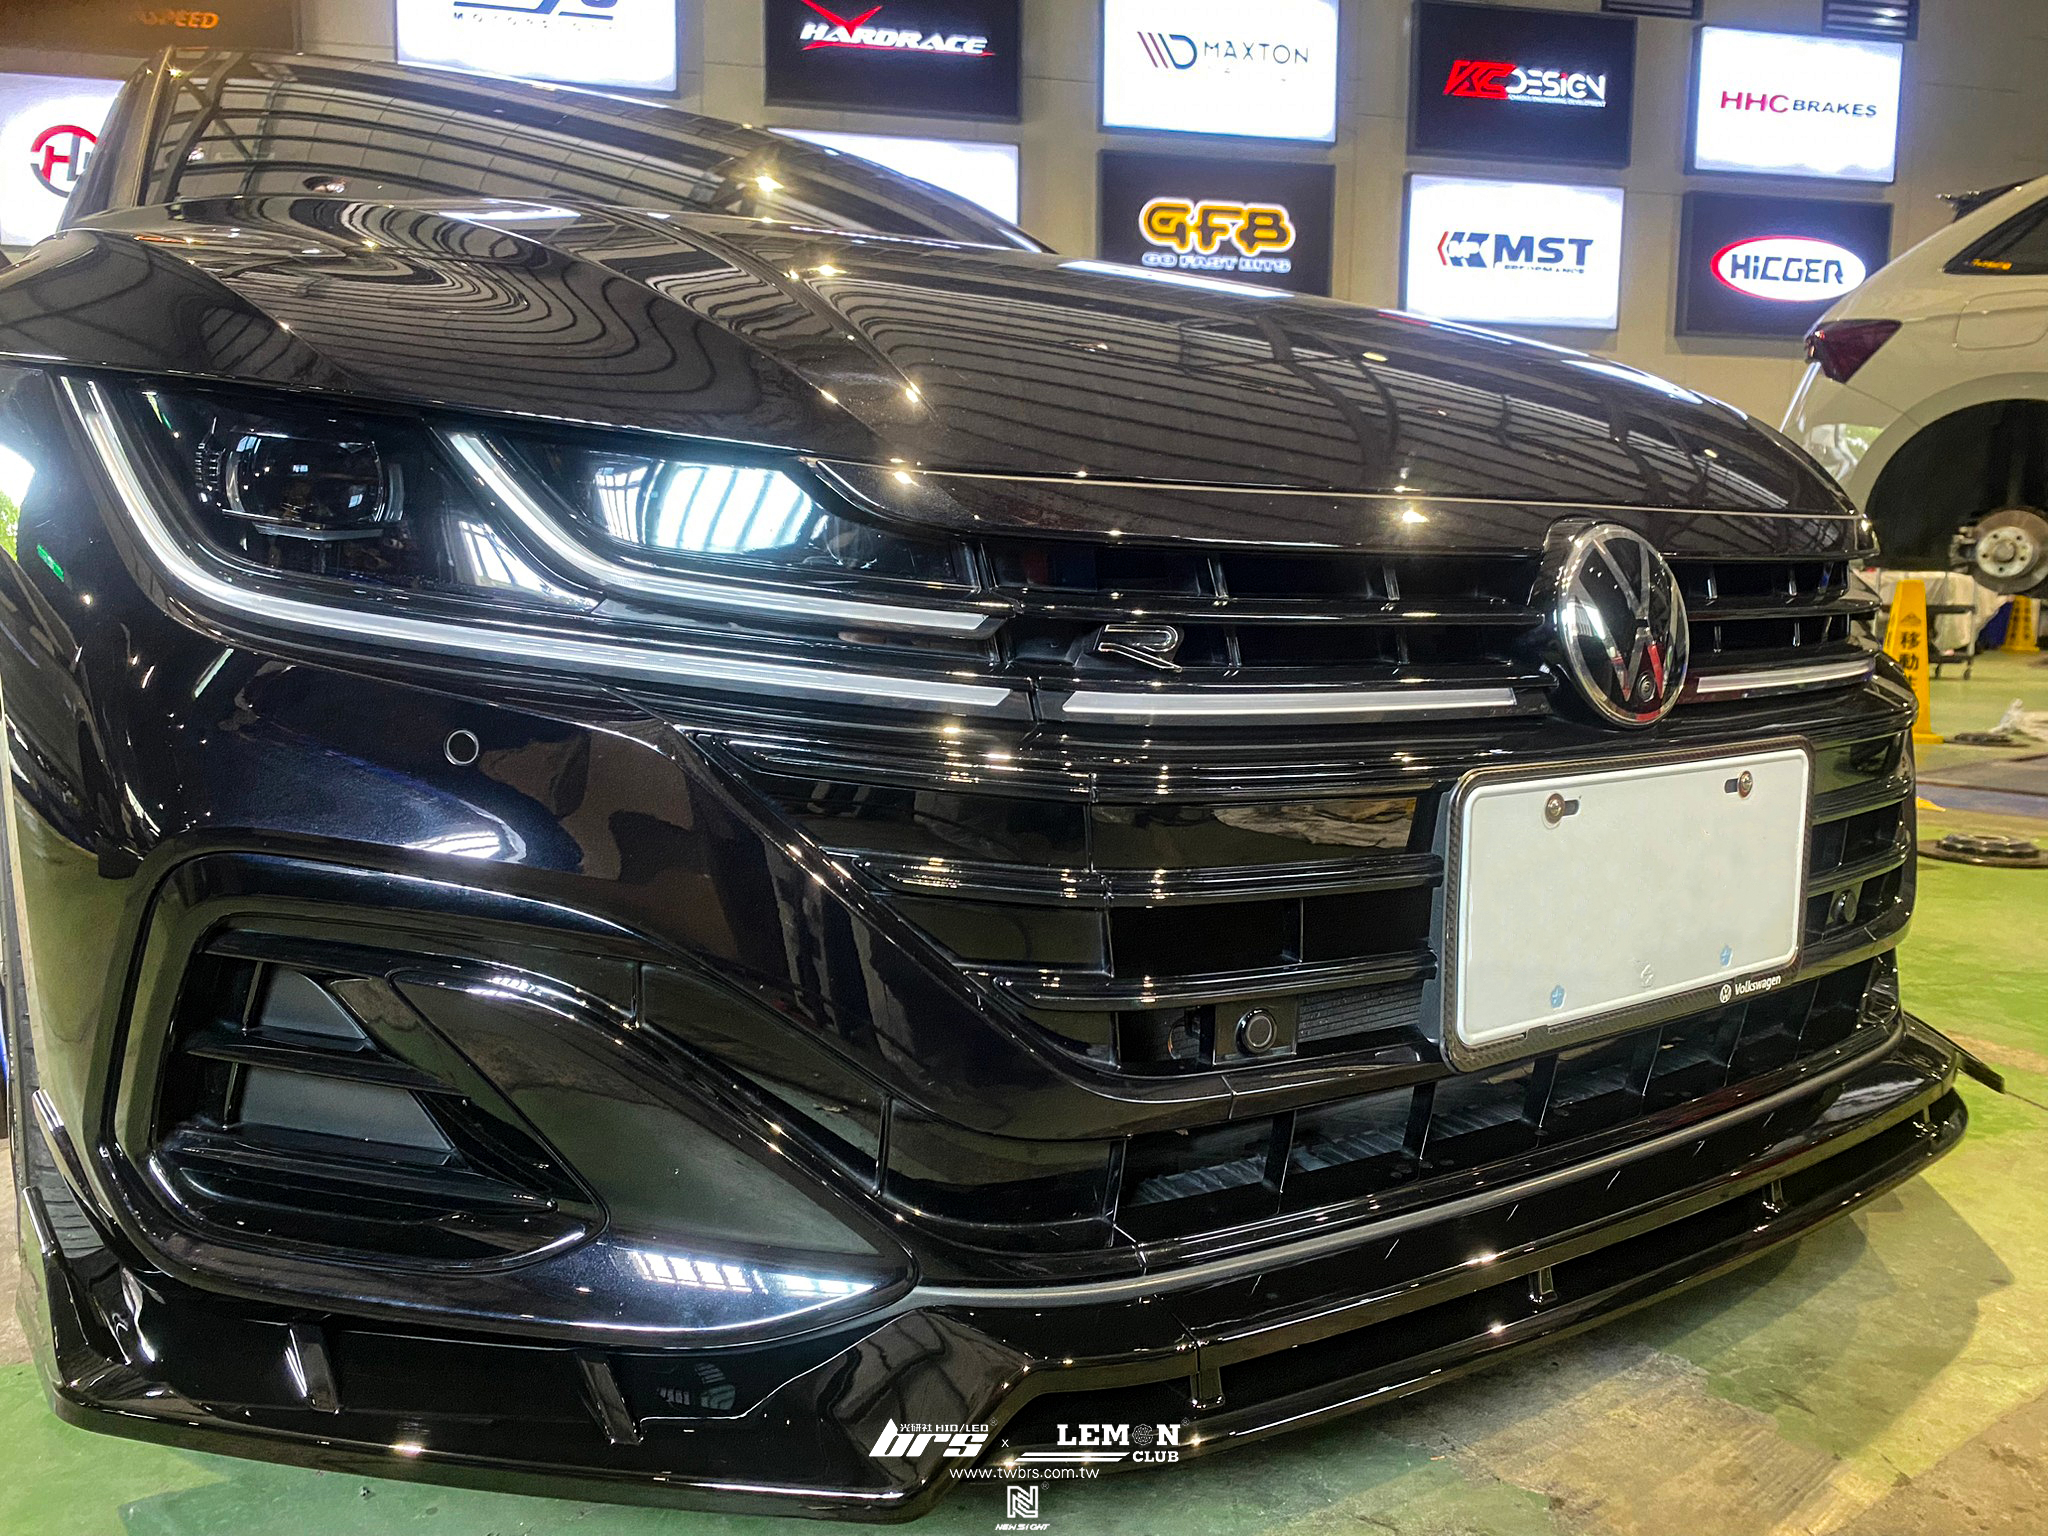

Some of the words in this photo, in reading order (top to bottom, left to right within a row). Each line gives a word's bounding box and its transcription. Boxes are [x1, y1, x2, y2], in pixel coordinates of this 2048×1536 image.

[800, 22, 988, 54] HARDRACE
[1204, 40, 1309, 64] MAXTON
[1720, 90, 1790, 114] HHC
[1792, 99, 1877, 117] BRAKES
[1138, 196, 1297, 257] GFB
[1141, 251, 1178, 268] GO
[1493, 233, 1594, 266] MST
[1734, 975, 1782, 996] Volkswagen
